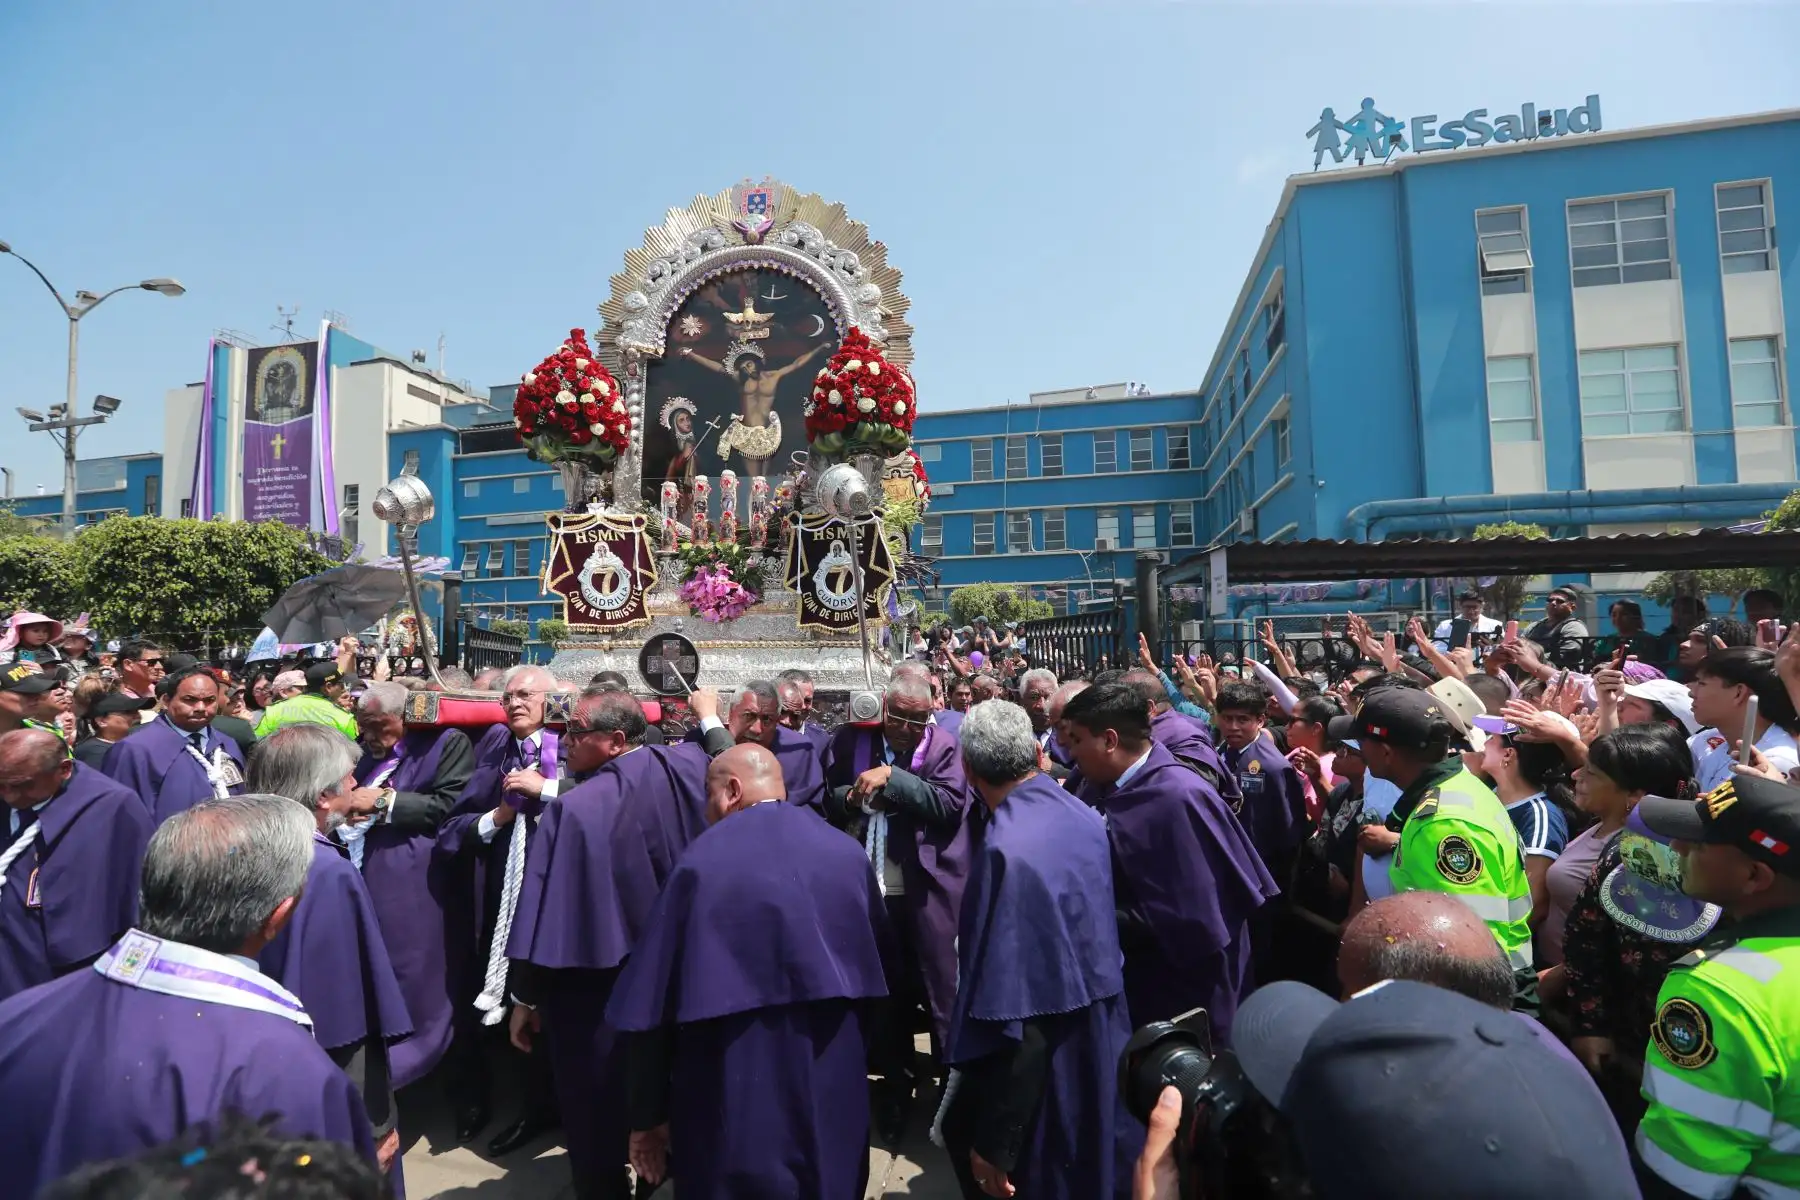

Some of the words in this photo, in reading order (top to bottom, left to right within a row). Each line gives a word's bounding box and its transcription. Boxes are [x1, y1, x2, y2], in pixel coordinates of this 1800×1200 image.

[1411, 94, 1602, 152] EsSalud
[575, 529, 626, 544] HSMN
[813, 525, 865, 541] HSMN
[594, 567, 616, 597] 7
[829, 566, 850, 596] 7
[569, 590, 585, 613] CUNA
[589, 611, 601, 620] DE
[584, 586, 628, 607] CUADRILLA
[802, 591, 818, 613] CUNA
[819, 608, 831, 619] DE
[818, 589, 858, 607] CUADRIL
[1646, 924, 1662, 938] DE
[1662, 928, 1684, 941] LOS
